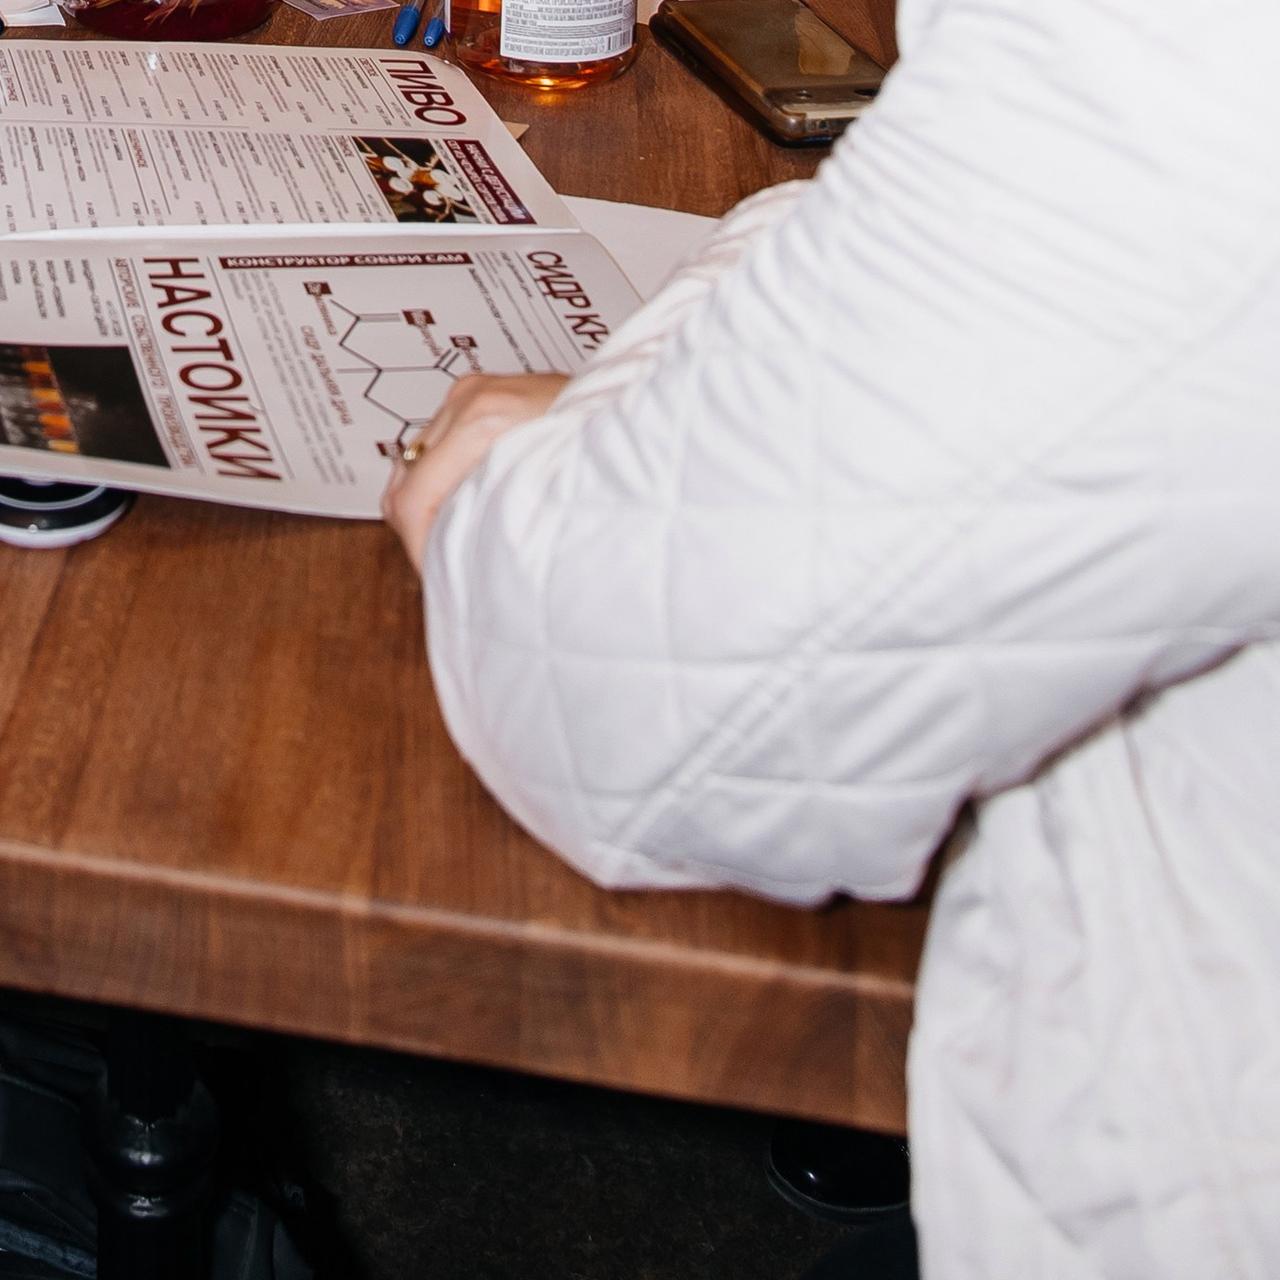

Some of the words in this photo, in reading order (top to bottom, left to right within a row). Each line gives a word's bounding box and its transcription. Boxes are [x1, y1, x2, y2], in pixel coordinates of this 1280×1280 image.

[379, 58, 466, 126] ПИВО
[227, 256, 350, 267] КОНСТРУКТОР
[354, 254, 422, 265] СОБЕРИ
[425, 253, 464, 264] САМ
[527, 250, 591, 308] СИДР
[565, 313, 608, 351] КР
[143, 257, 282, 480] НАСТОЙКИ
